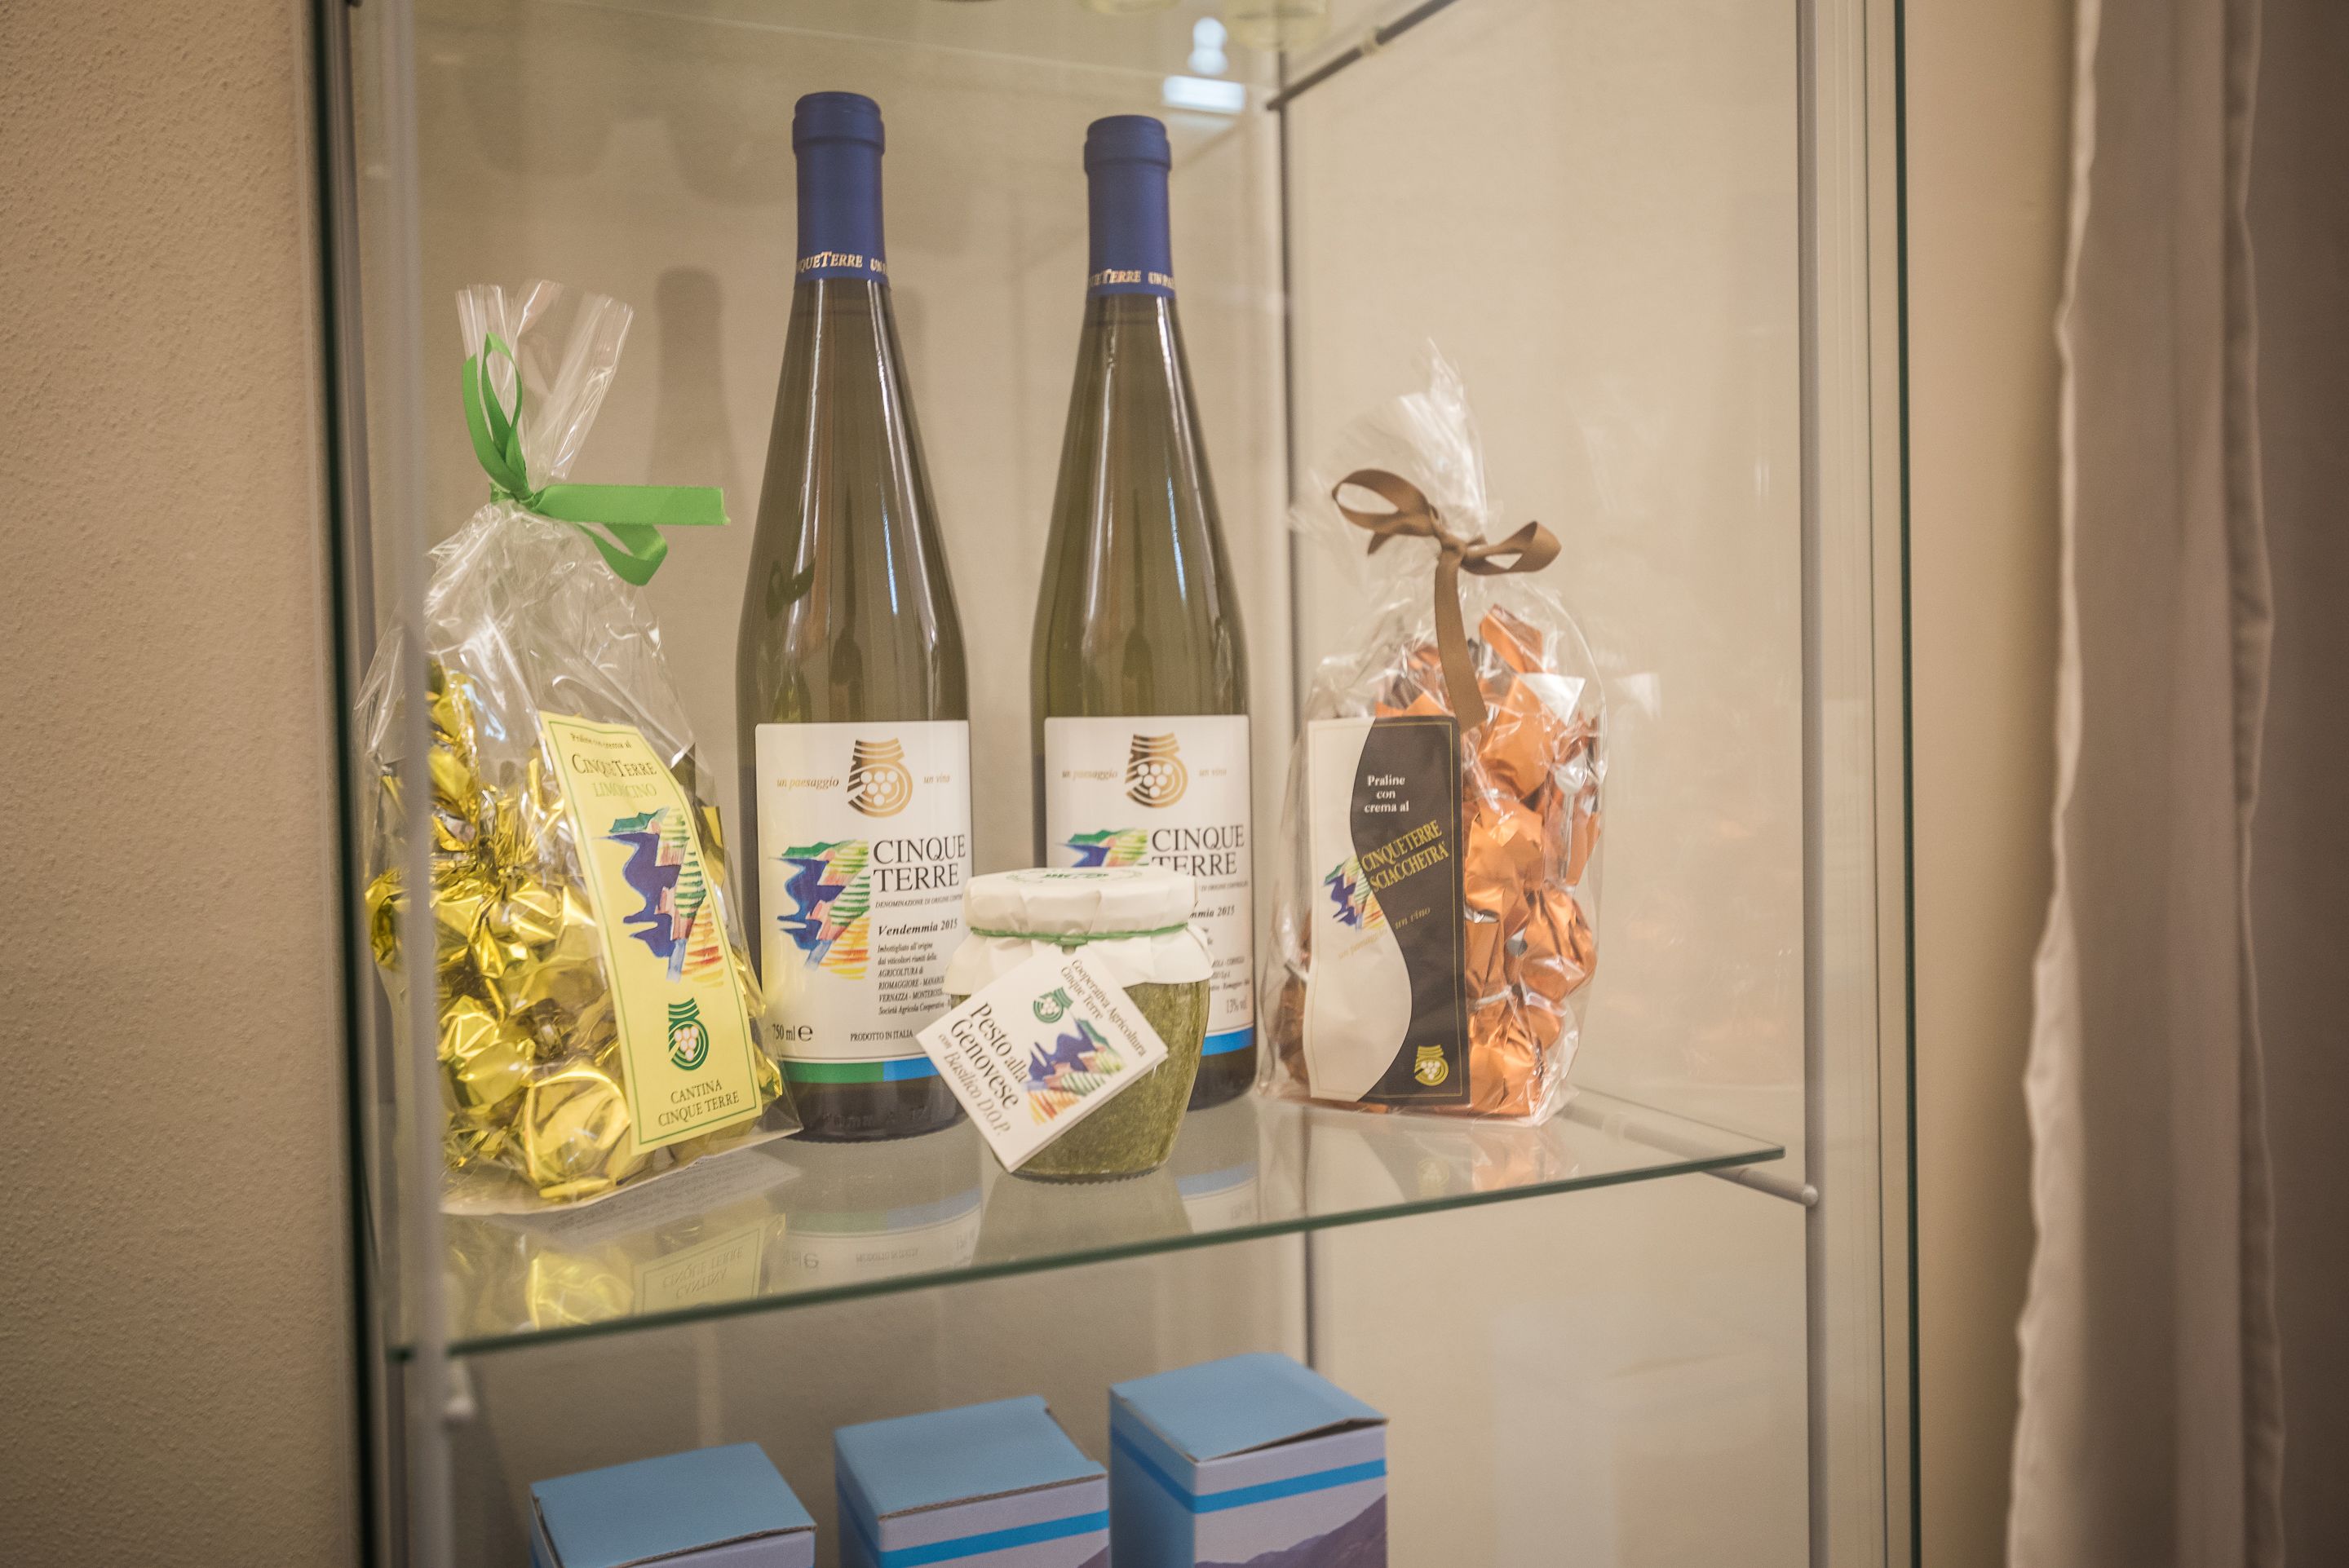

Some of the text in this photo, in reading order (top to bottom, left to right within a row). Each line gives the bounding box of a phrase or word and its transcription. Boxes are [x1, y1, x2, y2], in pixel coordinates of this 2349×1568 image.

[789, 776, 839, 790] paesaggio
[1367, 774, 1405, 786] Praline
[1376, 790, 1396, 799] con
[1364, 800, 1409, 813] crema al
[1152, 824, 1245, 852] CINQUE
[1361, 819, 1442, 872] CINQUETERRE
[873, 834, 967, 864] CINQUE
[873, 863, 960, 893] TERRE
[875, 899, 923, 908] DENOMINAZIONE
[1218, 905, 1235, 917] 2015
[878, 918, 958, 936] Vendemmia 2015
[878, 967, 918, 978] AGRICOLTURA
[878, 979, 920, 991] RIOMAGGIORE
[1060, 965, 1104, 1020] Cinque Terre
[878, 992, 908, 1003] VERNAZZA
[1072, 958, 1147, 1057] Cooperativa Agricoltura
[785, 1025, 795, 1041] ml
[850, 1029, 914, 1042] PRODOTTO IN ITALIA
[938, 1034, 953, 1050] con
[970, 1002, 1029, 1084] Pesto alla
[950, 1018, 1020, 1110] Genovese
[943, 1050, 982, 1101] Basilico
[670, 1079, 723, 1105] CANTINA
[658, 1091, 740, 1127] CINQUE TERRE
